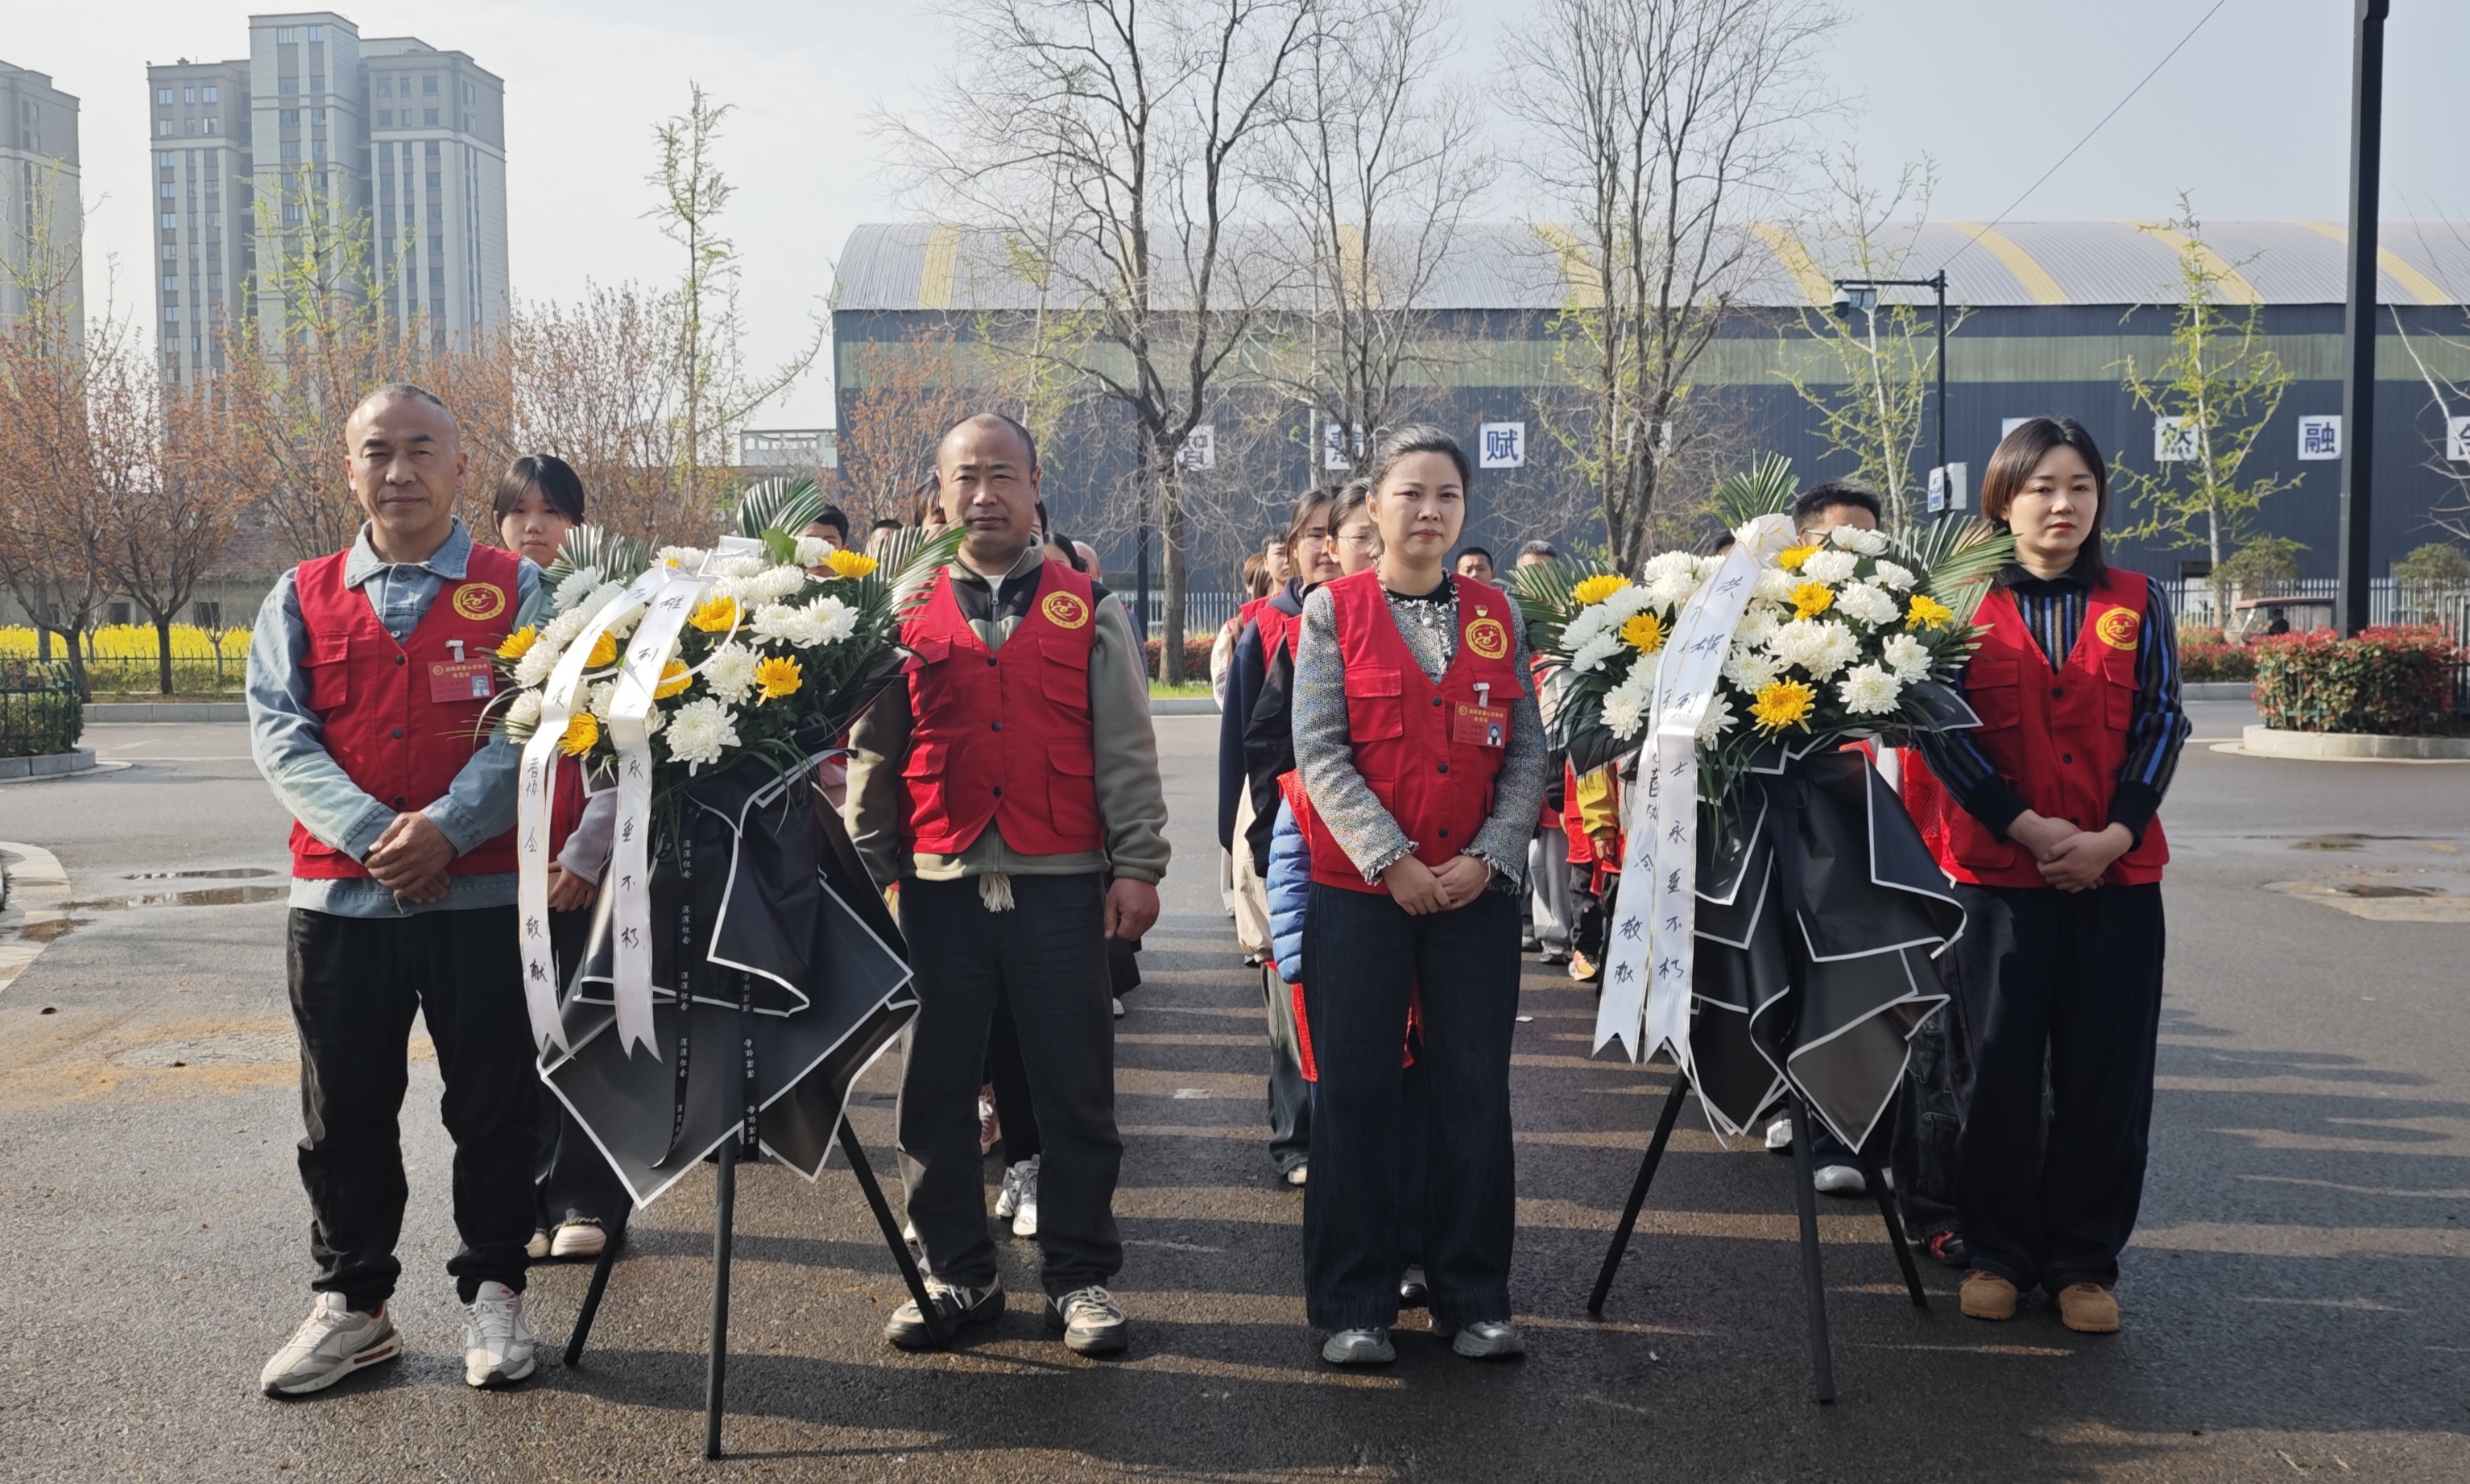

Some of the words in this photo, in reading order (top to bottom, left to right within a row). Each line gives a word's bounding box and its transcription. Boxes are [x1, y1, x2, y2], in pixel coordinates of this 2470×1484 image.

[1486, 428, 1519, 461] 赋
[2304, 422, 2336, 454] 融
[682, 839, 693, 879] 深深怀念
[681, 905, 692, 945] 深深怀念
[680, 971, 690, 1011] 深深怀念
[679, 1037, 689, 1078] 深深怀念
